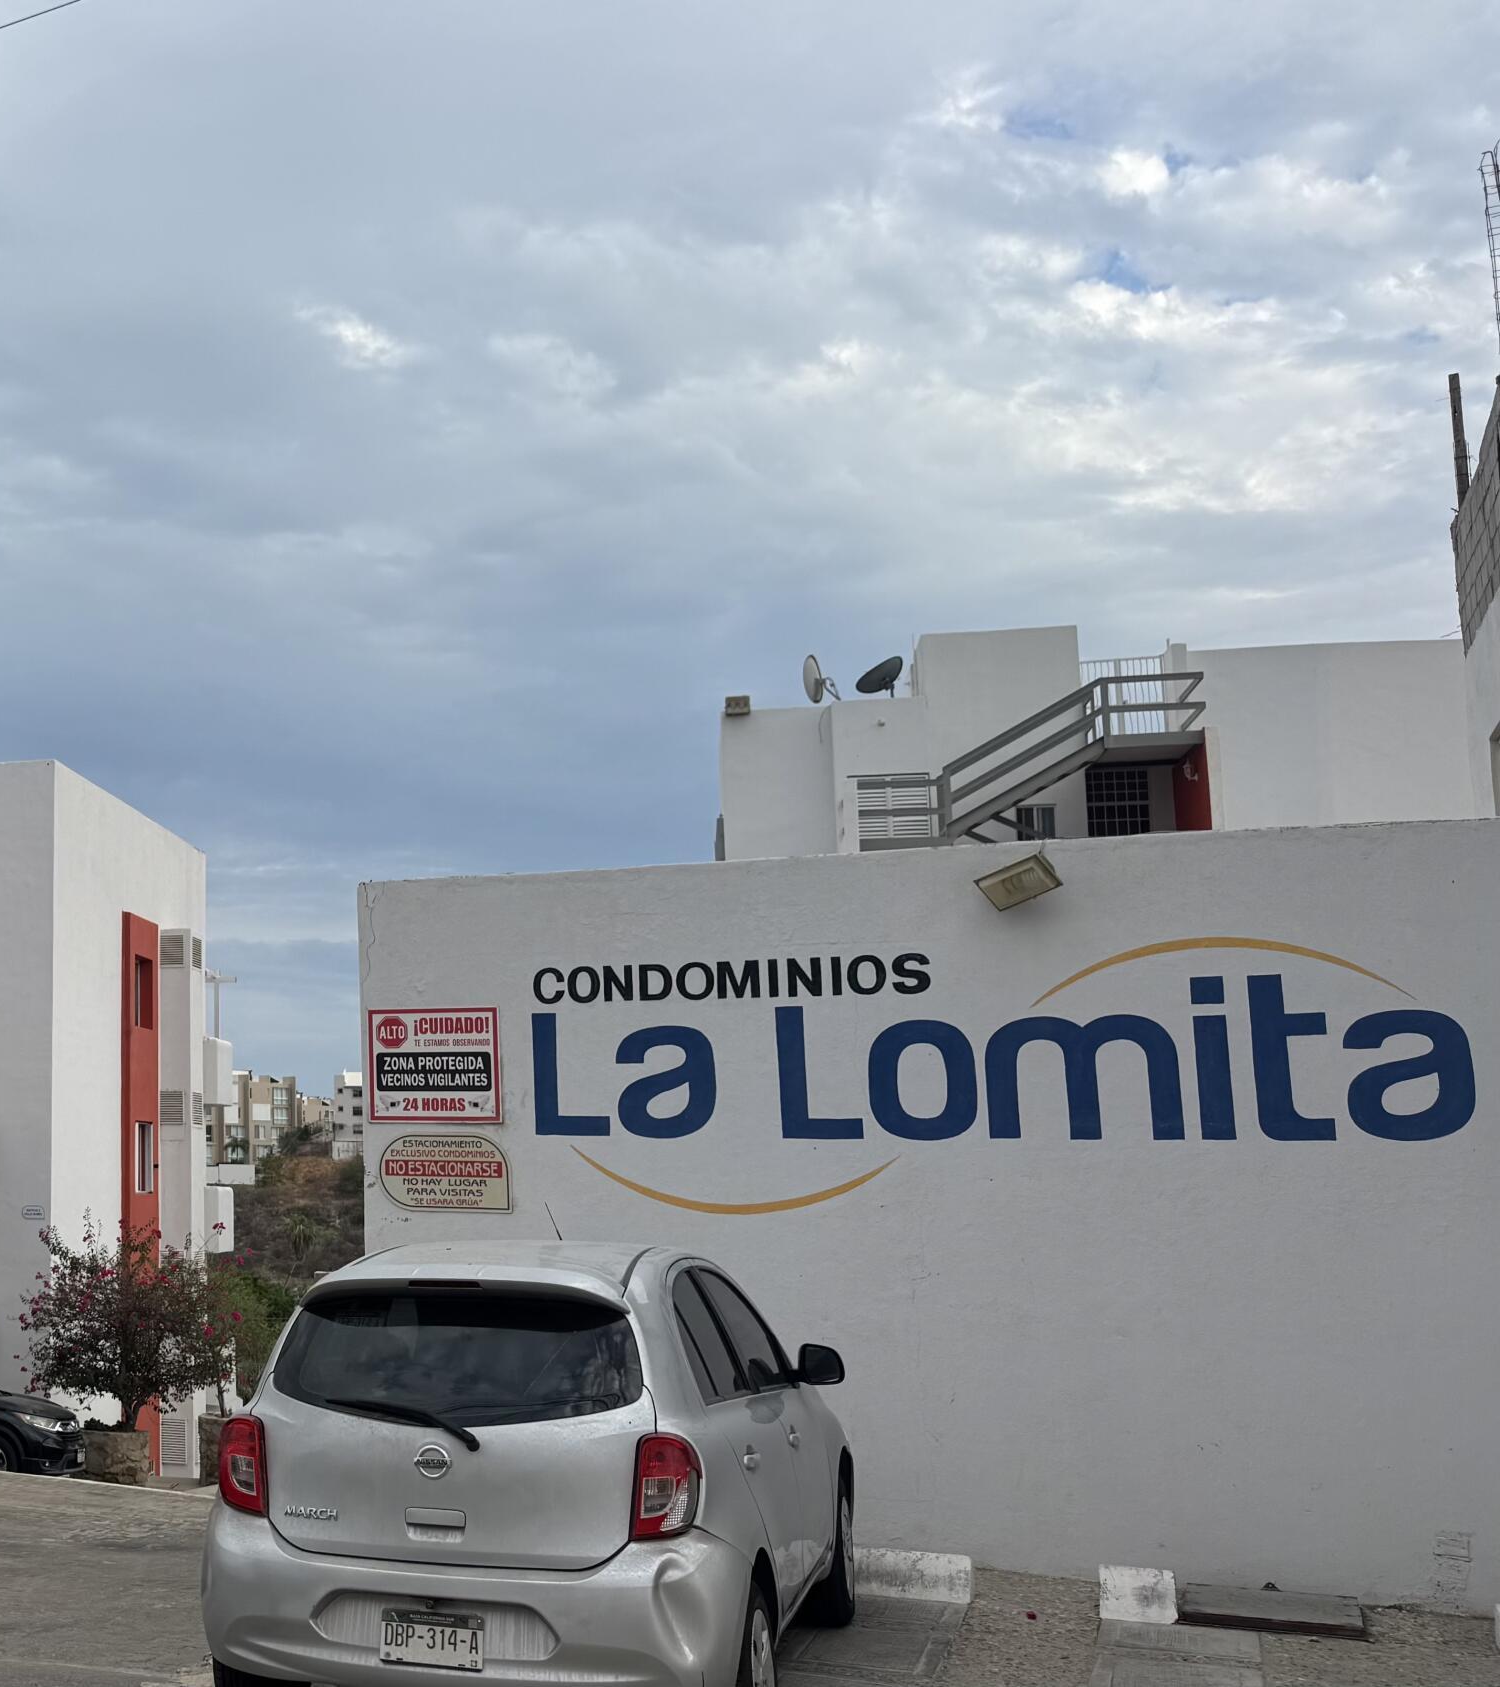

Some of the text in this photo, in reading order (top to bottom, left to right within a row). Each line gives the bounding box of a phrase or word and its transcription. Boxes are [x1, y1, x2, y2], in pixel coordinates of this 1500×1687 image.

[533, 952, 931, 1004] CONDOMINIOS
[379, 1025, 405, 1040] ALTO
[413, 1016, 490, 1036] ¡CUIDADO!
[423, 1039, 450, 1047] ESTAMOS
[452, 1039, 490, 1047] OBSERVANDO
[383, 1056, 484, 1071] ZONA PROTEGIDA
[531, 972, 1477, 1143] La Lomita
[380, 1073, 488, 1087] VECINOS VIGILANTES
[402, 1097, 466, 1112] 24 HORAS
[402, 1139, 483, 1149] ESTACIONAMIENTO
[390, 1149, 496, 1159] EXCLUSIVO CONDOMINIOS
[388, 1161, 499, 1177] NO ESTACIONARSE
[402, 1178, 488, 1187] NO HAY LUGAR
[406, 1188, 484, 1197] PARA VISITAS
[284, 1504, 338, 1521] MARCH
[384, 1622, 479, 1655] DBP-314-A
